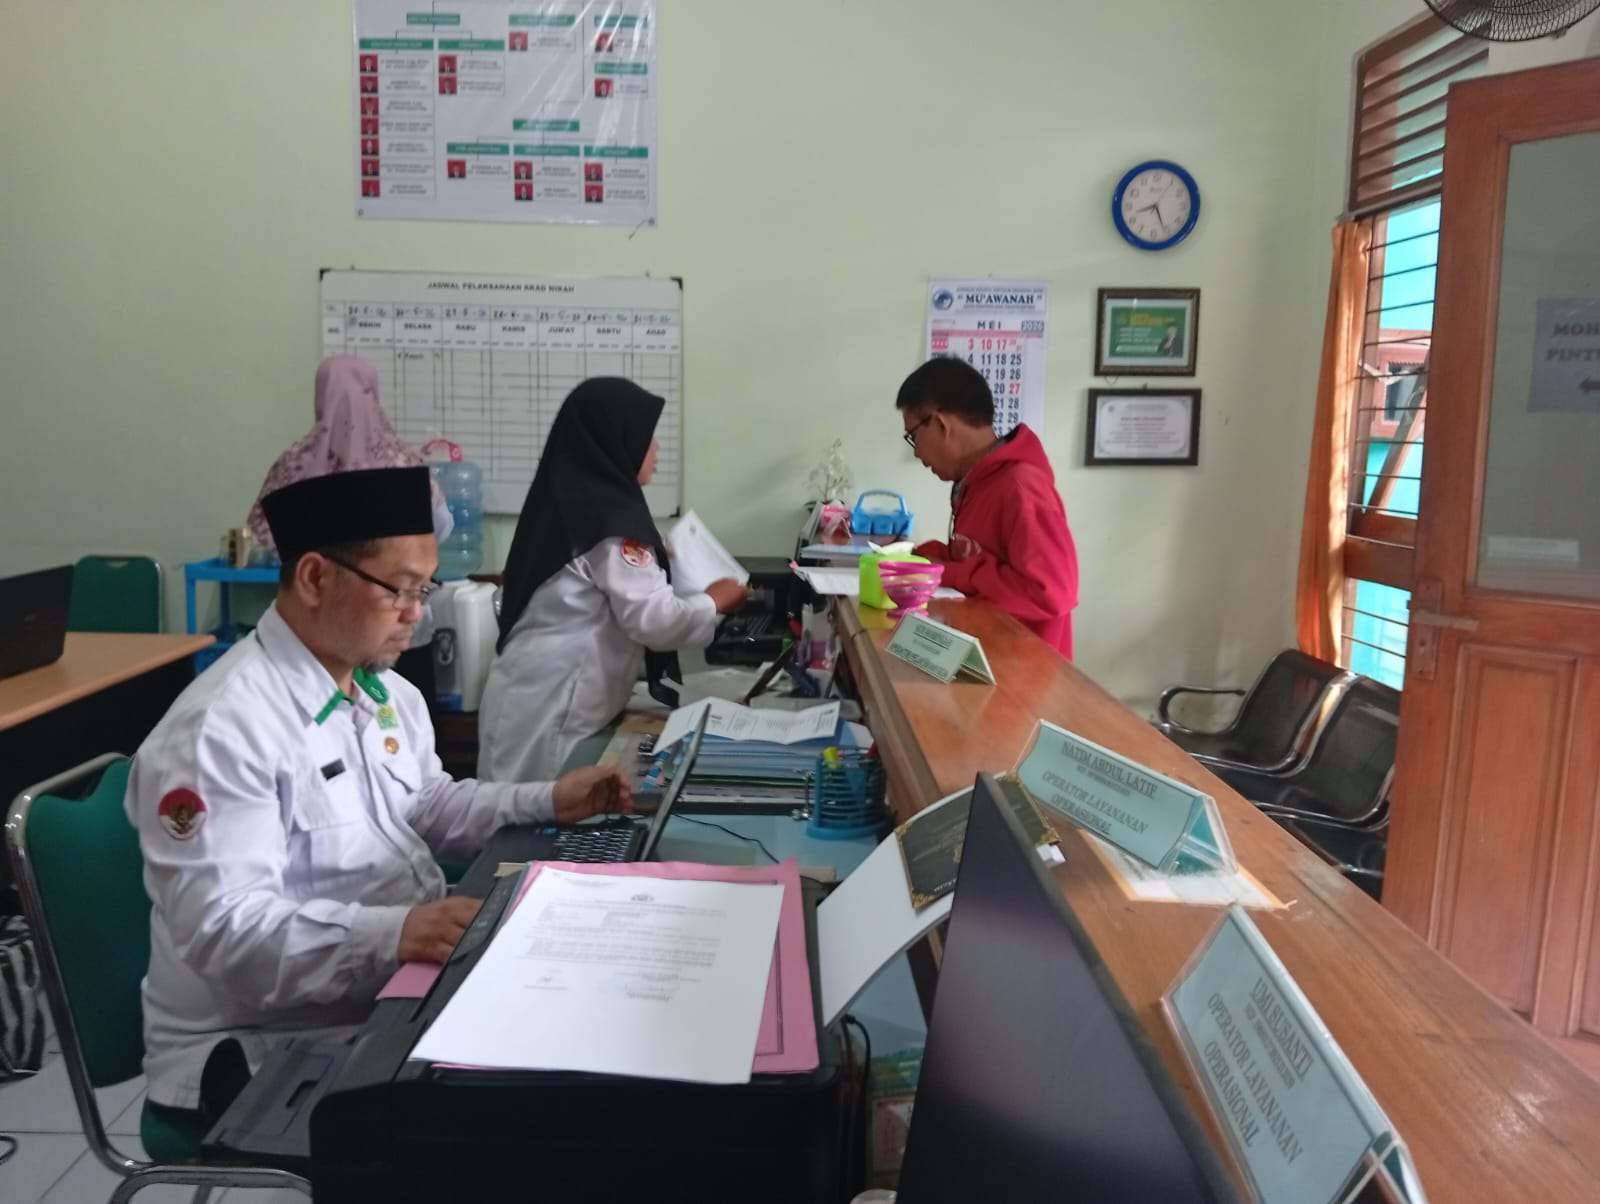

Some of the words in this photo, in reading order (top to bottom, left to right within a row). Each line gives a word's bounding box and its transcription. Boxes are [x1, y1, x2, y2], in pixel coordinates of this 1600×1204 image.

[966, 294, 1035, 304] MU'AWANAH
[977, 320, 1001, 329] MEI
[968, 339, 975, 351] 3
[982, 339, 993, 350] 10
[997, 339, 1007, 351] 17
[982, 354, 992, 365] 11
[996, 354, 1007, 366] 18
[1011, 353, 1022, 366] 25
[996, 369, 1006, 381] 19
[994, 383, 1005, 395] 20
[1009, 383, 1021, 395] 27
[1008, 397, 1020, 409] 28
[1042, 770, 1090, 803] OPERATOR
[1087, 793, 1149, 834] LAYANANAN
[1207, 992, 1251, 1068] OPERATOR
[1242, 1060, 1304, 1165] LAYANANAN
[1203, 1040, 1260, 1148] OPERASIONAL
